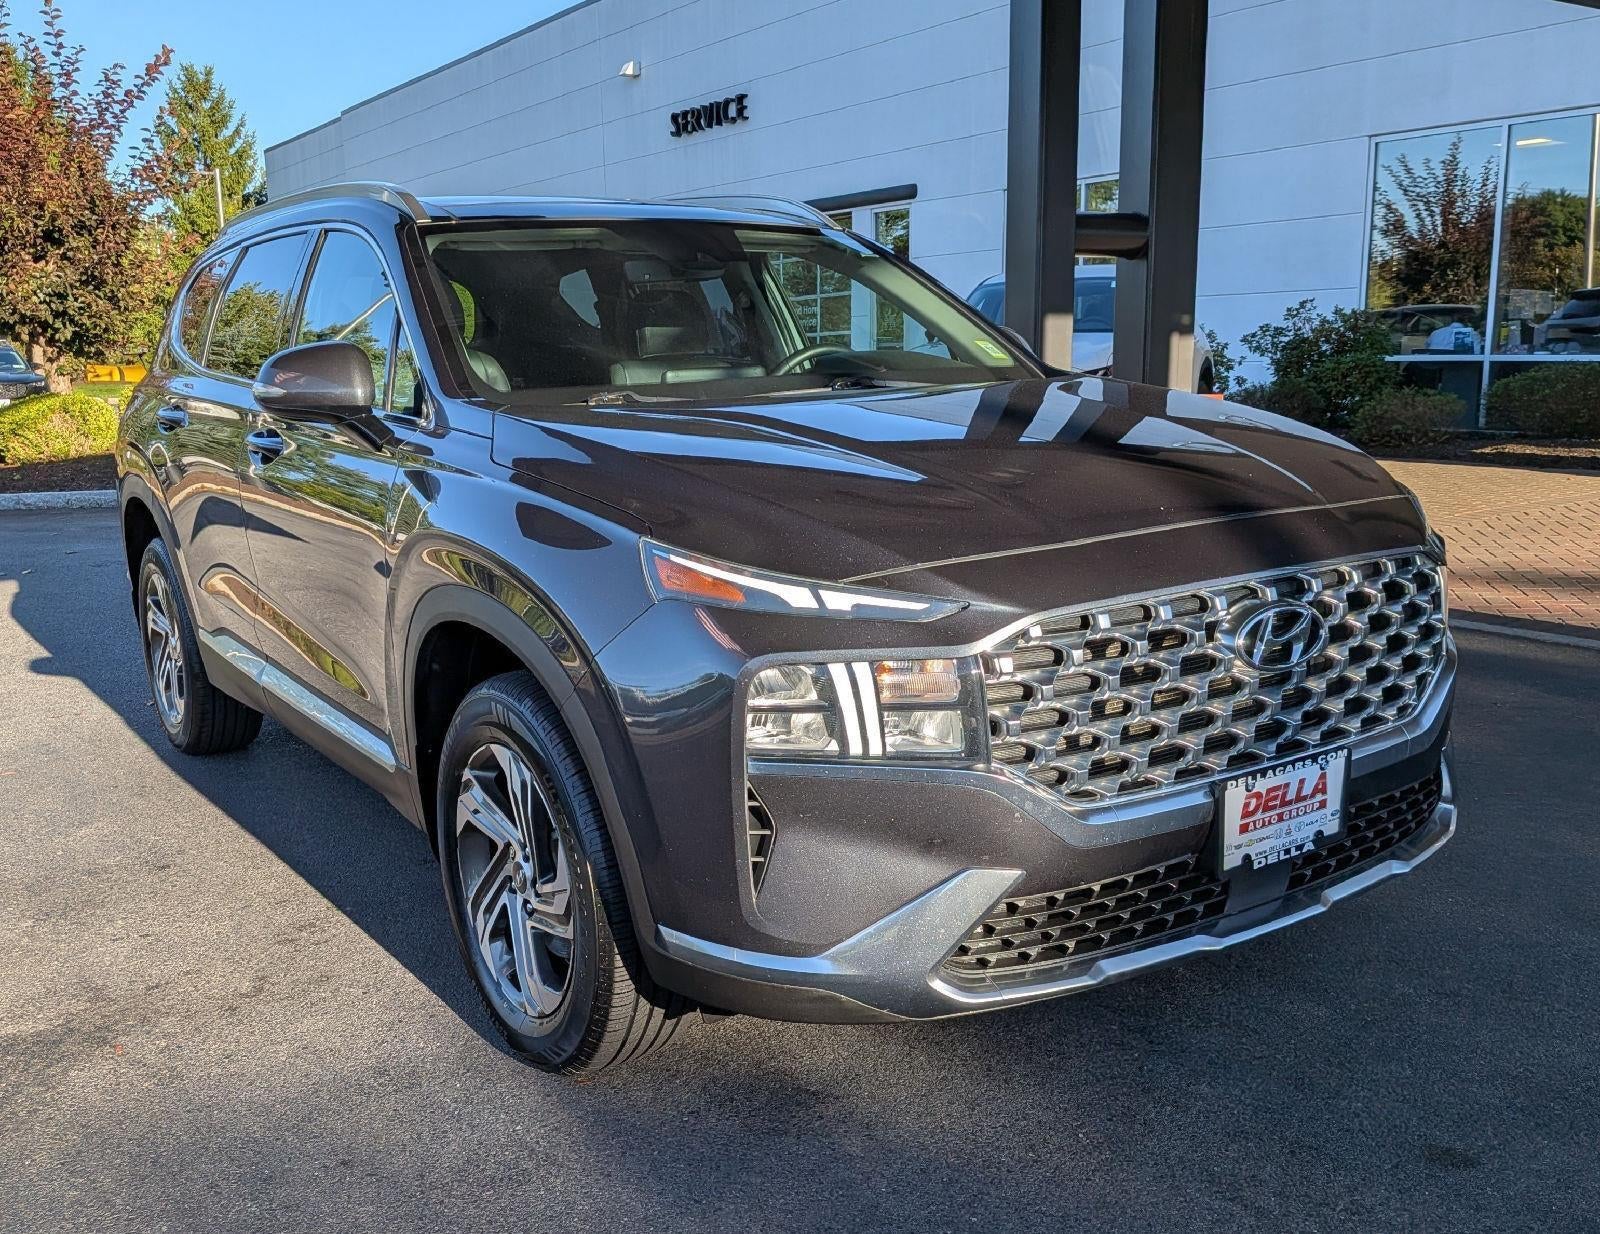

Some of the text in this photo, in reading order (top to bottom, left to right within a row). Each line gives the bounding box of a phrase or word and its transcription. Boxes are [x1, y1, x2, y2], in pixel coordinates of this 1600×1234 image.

[670, 93, 750, 138] SERVICE
[1226, 748, 1348, 790] DELLACARS.COM
[1239, 770, 1328, 820] DELLA
[1247, 801, 1320, 832] AUTO GROUP
[1252, 841, 1315, 870] DELLA
